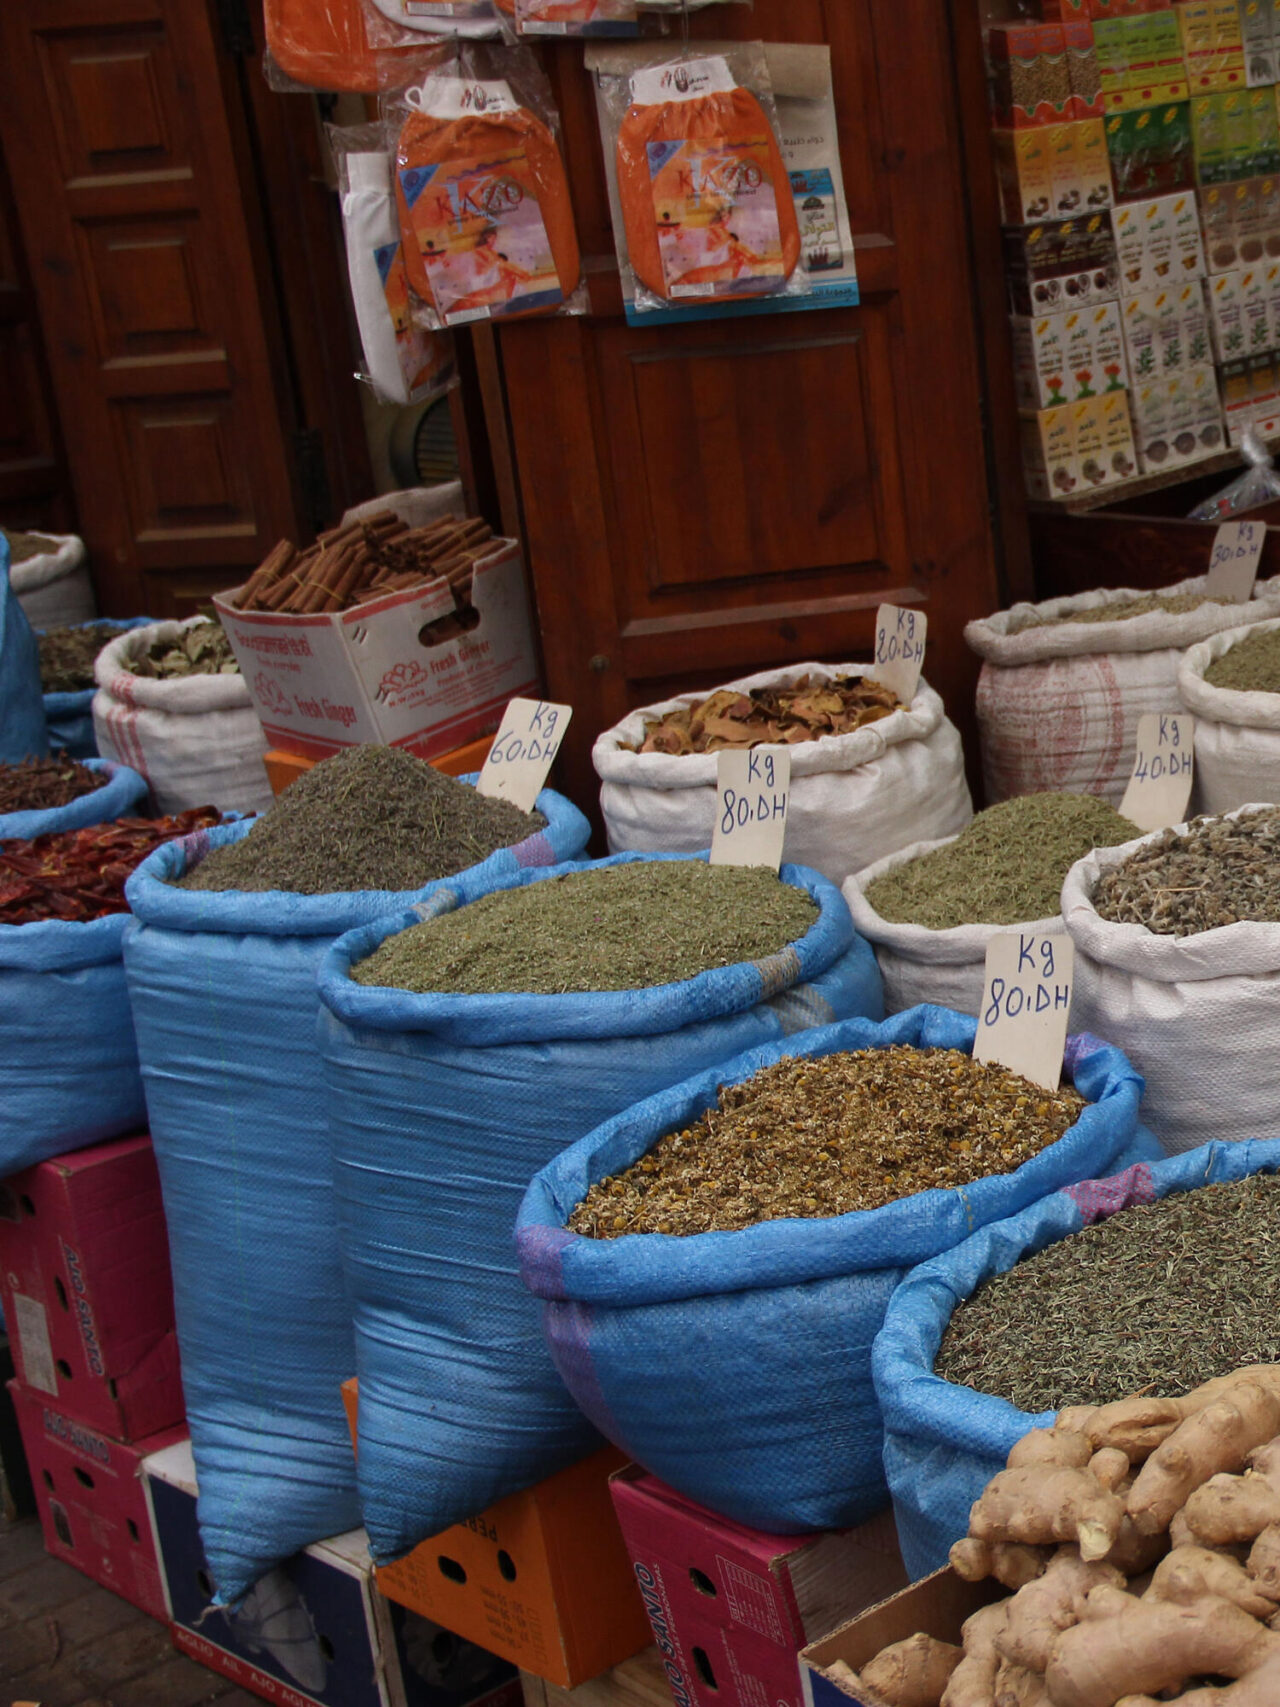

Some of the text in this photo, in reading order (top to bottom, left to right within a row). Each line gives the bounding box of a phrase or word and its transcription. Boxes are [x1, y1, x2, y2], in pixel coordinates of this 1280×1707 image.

[677, 166, 762, 194] KAZO
[435, 182, 524, 222] KAZO
[897, 607, 915, 640] Kg
[529, 701, 559, 739] Kg
[1158, 714, 1180, 747] Kg
[748, 750, 775, 788] Kg
[1018, 933, 1055, 979] Kg
[633, 1561, 677, 1660] SANTO
